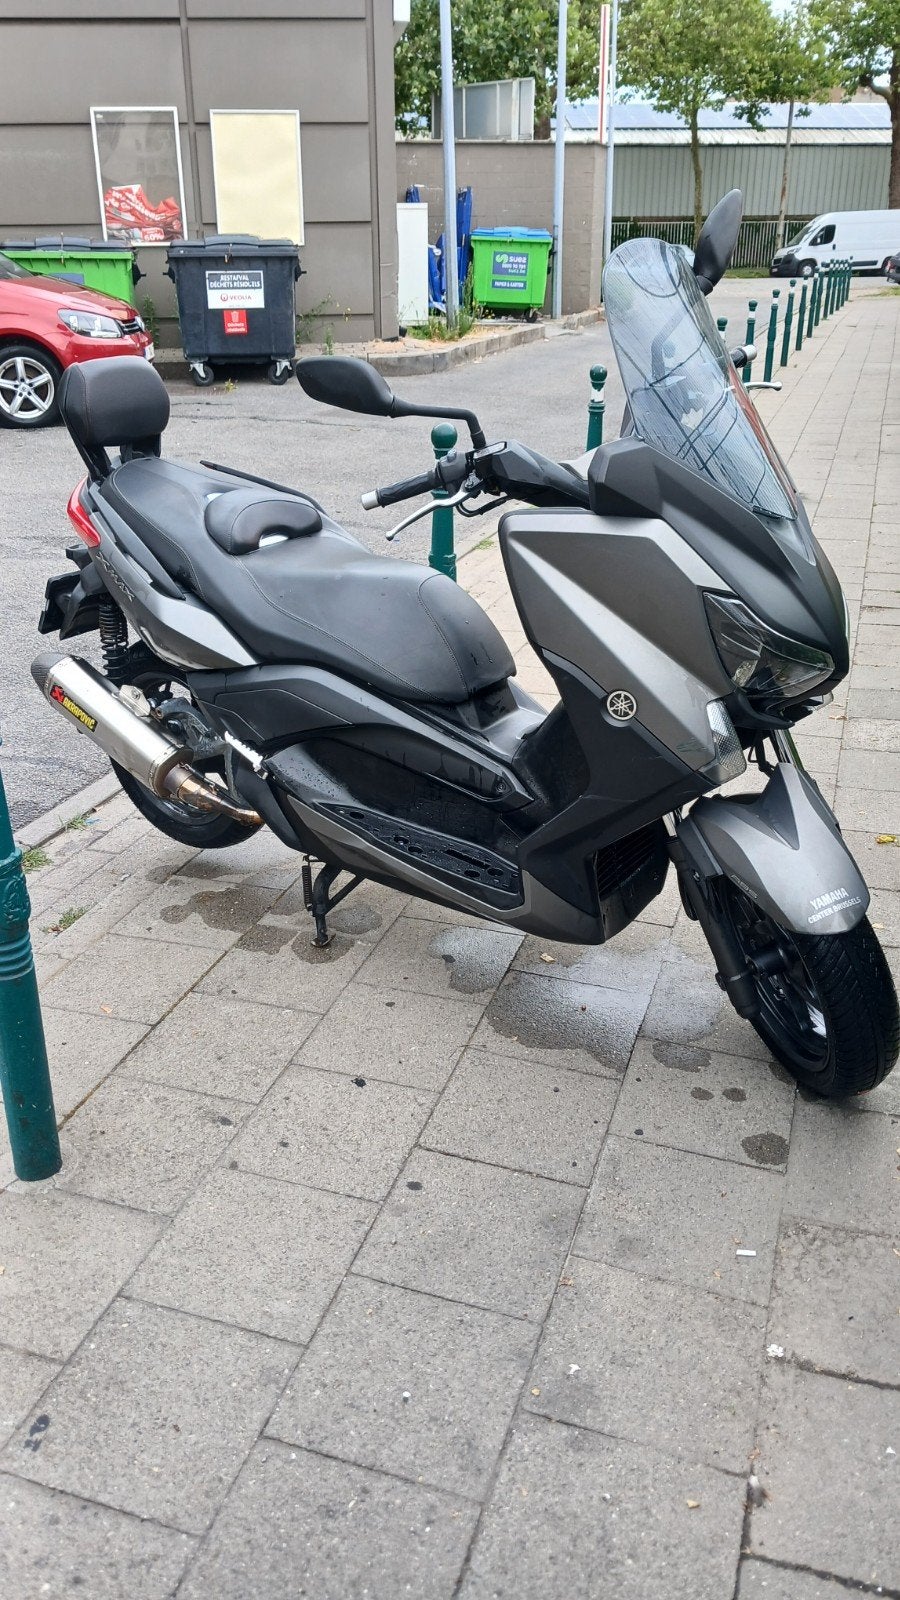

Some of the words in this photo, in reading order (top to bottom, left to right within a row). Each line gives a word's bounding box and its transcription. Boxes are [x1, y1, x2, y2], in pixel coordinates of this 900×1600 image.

[808, 907, 834, 924] CENTER
[832, 896, 862, 912] BRUSSELS
[810, 887, 849, 910] YAMAHA
